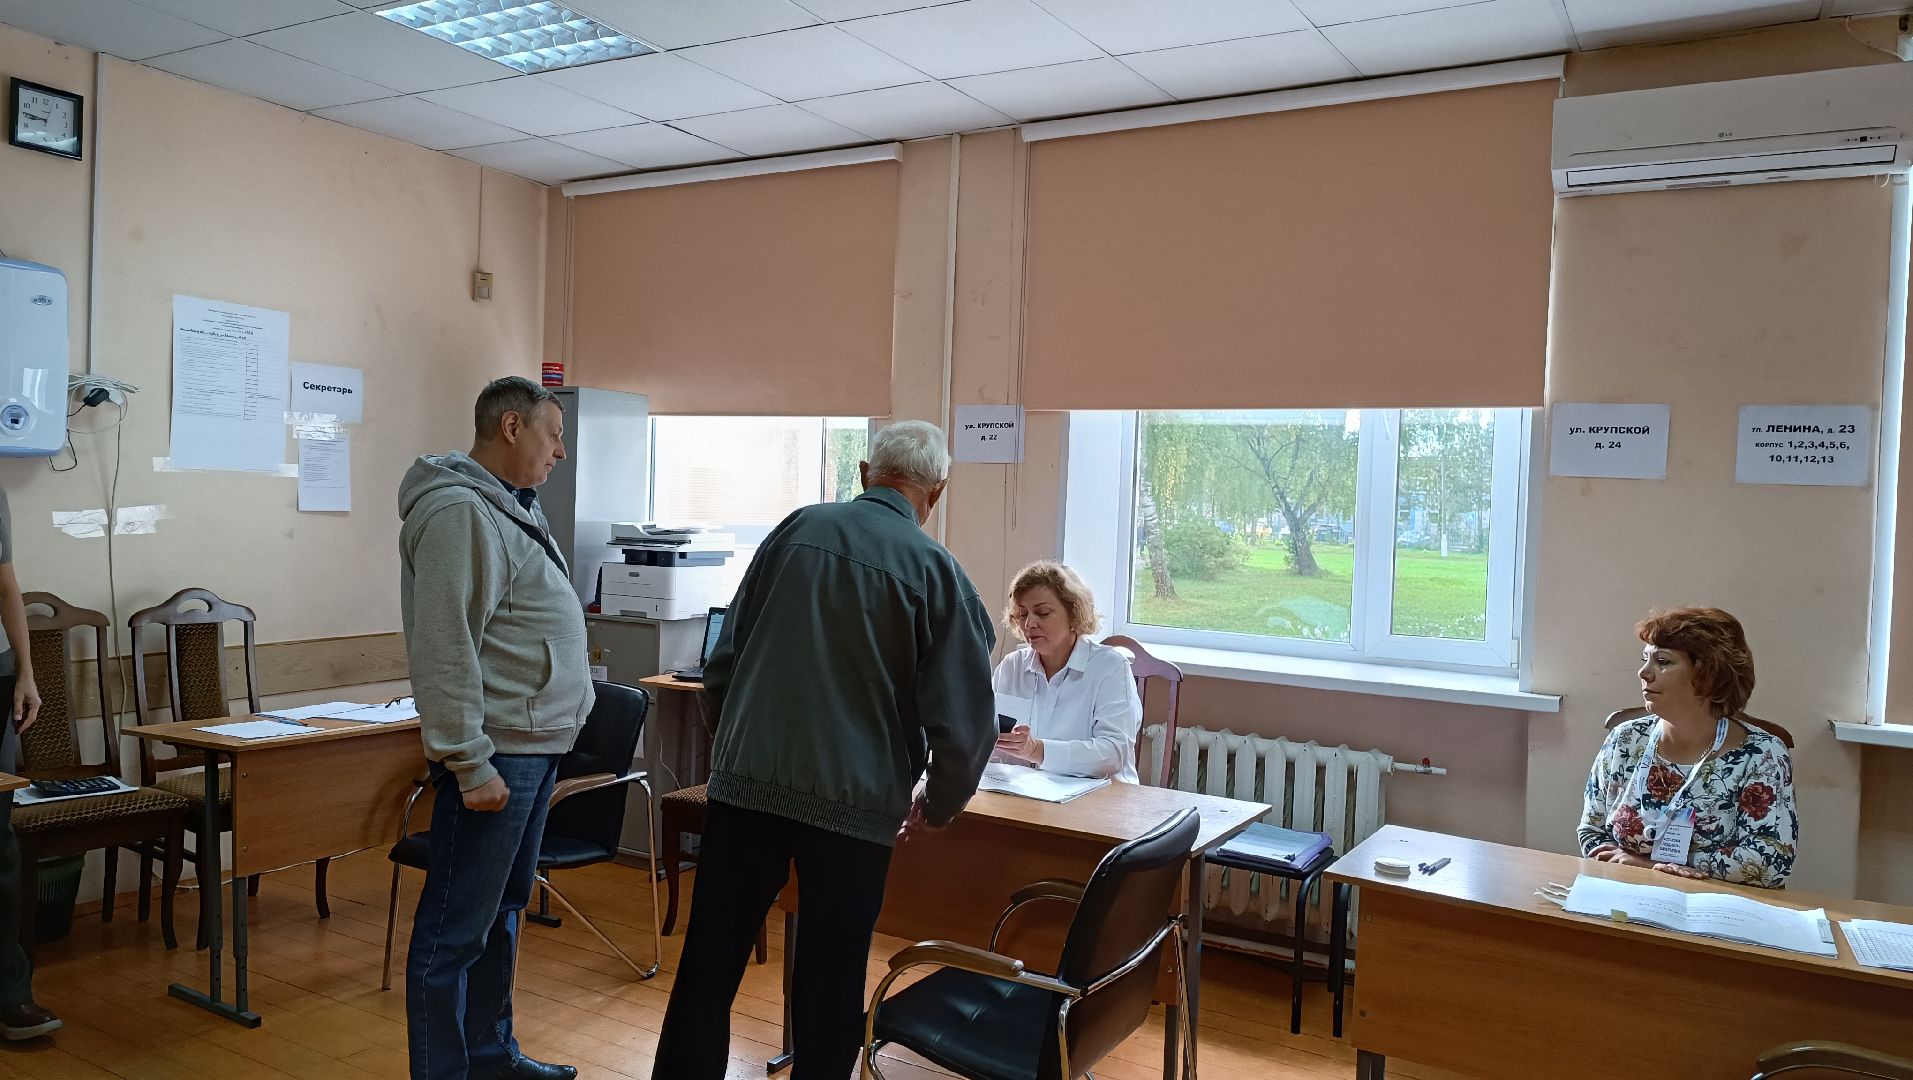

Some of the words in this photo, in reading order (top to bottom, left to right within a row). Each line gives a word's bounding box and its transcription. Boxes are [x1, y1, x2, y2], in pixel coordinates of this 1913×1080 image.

[32, 97, 38, 105] 11
[43, 98, 50, 106] 12
[23, 102, 31, 110] 10
[302, 381, 353, 395] Секретарь
[977, 421, 1014, 429] КРУПСКОЙ
[1765, 425, 1824, 435] ЛЕНИНА,
[1838, 424, 1856, 434] 23
[1568, 427, 1585, 435] ул.
[1588, 426, 1650, 435] КРУПСКОЙ
[1594, 442, 1605, 450] д.
[1608, 441, 1622, 449] 24
[1787, 440, 1850, 450] 1,2,3,4,5,6,
[1768, 454, 1835, 465] 10,11,12,13
